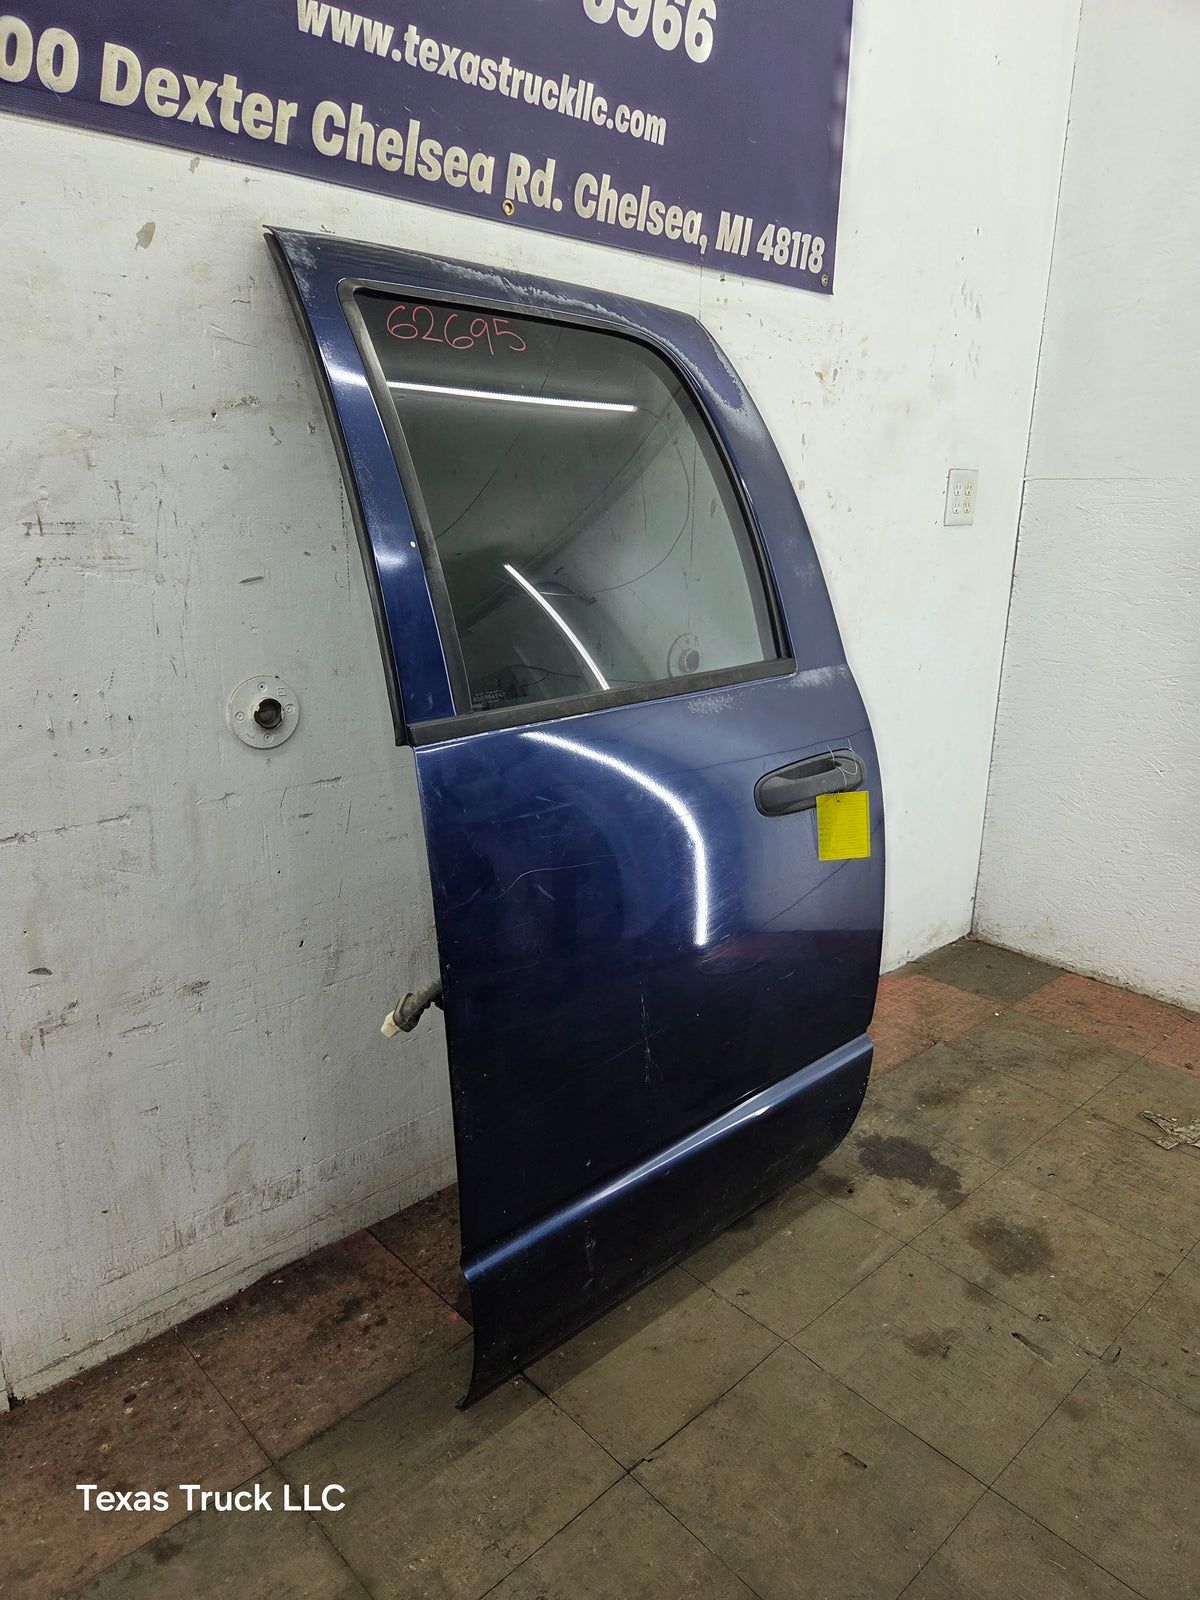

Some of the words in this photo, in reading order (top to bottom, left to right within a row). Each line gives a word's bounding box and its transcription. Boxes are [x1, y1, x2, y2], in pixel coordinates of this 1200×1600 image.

[297, 0, 667, 146] www.texastruckllc.com
[100, 42, 298, 146] Dexter
[311, 100, 496, 195] Chelsea
[504, 152, 563, 212] Rd.
[573, 172, 708, 255] Chelsea,
[715, 211, 753, 257] MI
[756, 224, 826, 274] 48118
[386, 305, 527, 356] 62695
